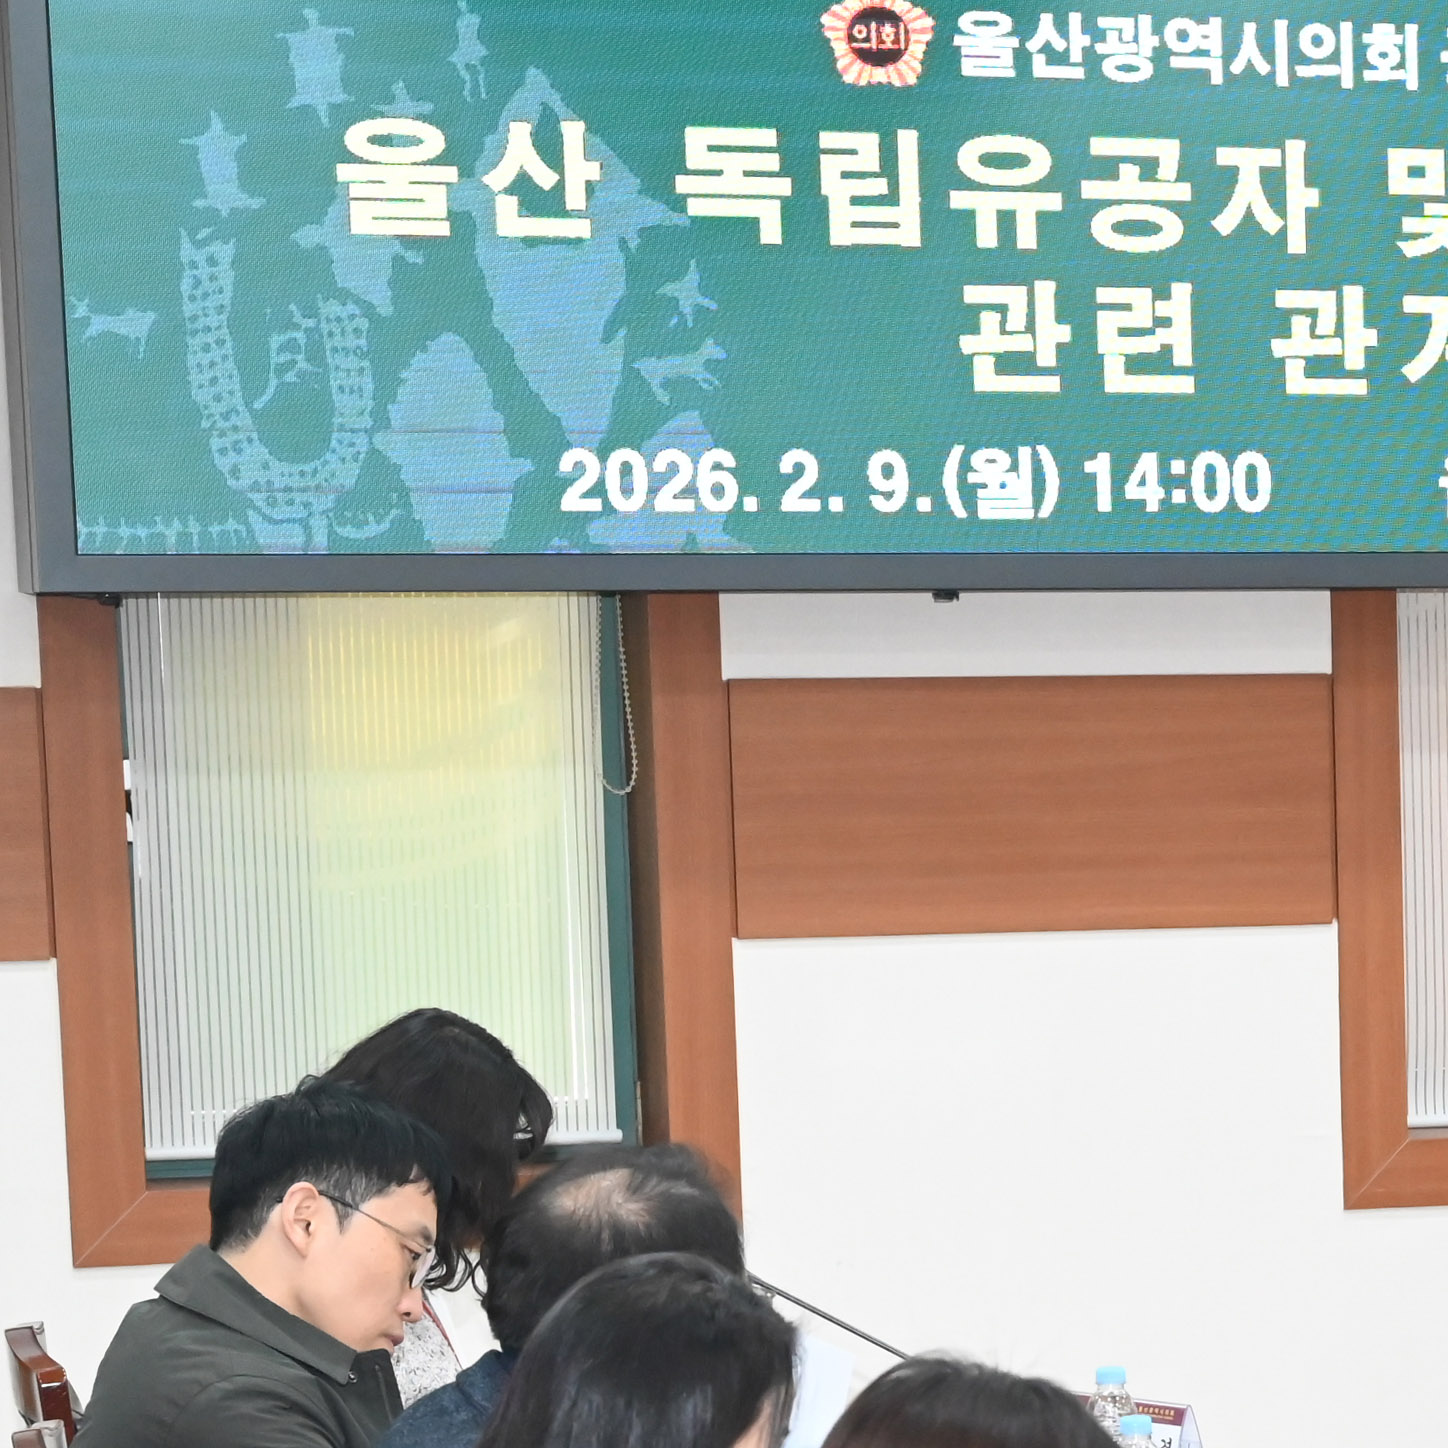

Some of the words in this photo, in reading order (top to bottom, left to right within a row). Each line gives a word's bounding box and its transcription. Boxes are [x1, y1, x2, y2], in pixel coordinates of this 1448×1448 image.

[953, 10, 1419, 91] 울산광역시의회
[336, 117, 601, 239] 울산
[675, 126, 1320, 255] 독립유공자
[959, 281, 1195, 394] 관련
[559, 447, 758, 513] 2026.
[779, 448, 844, 512] 2.
[867, 444, 1060, 520] 9.(월)
[1084, 450, 1272, 513] 14:00
